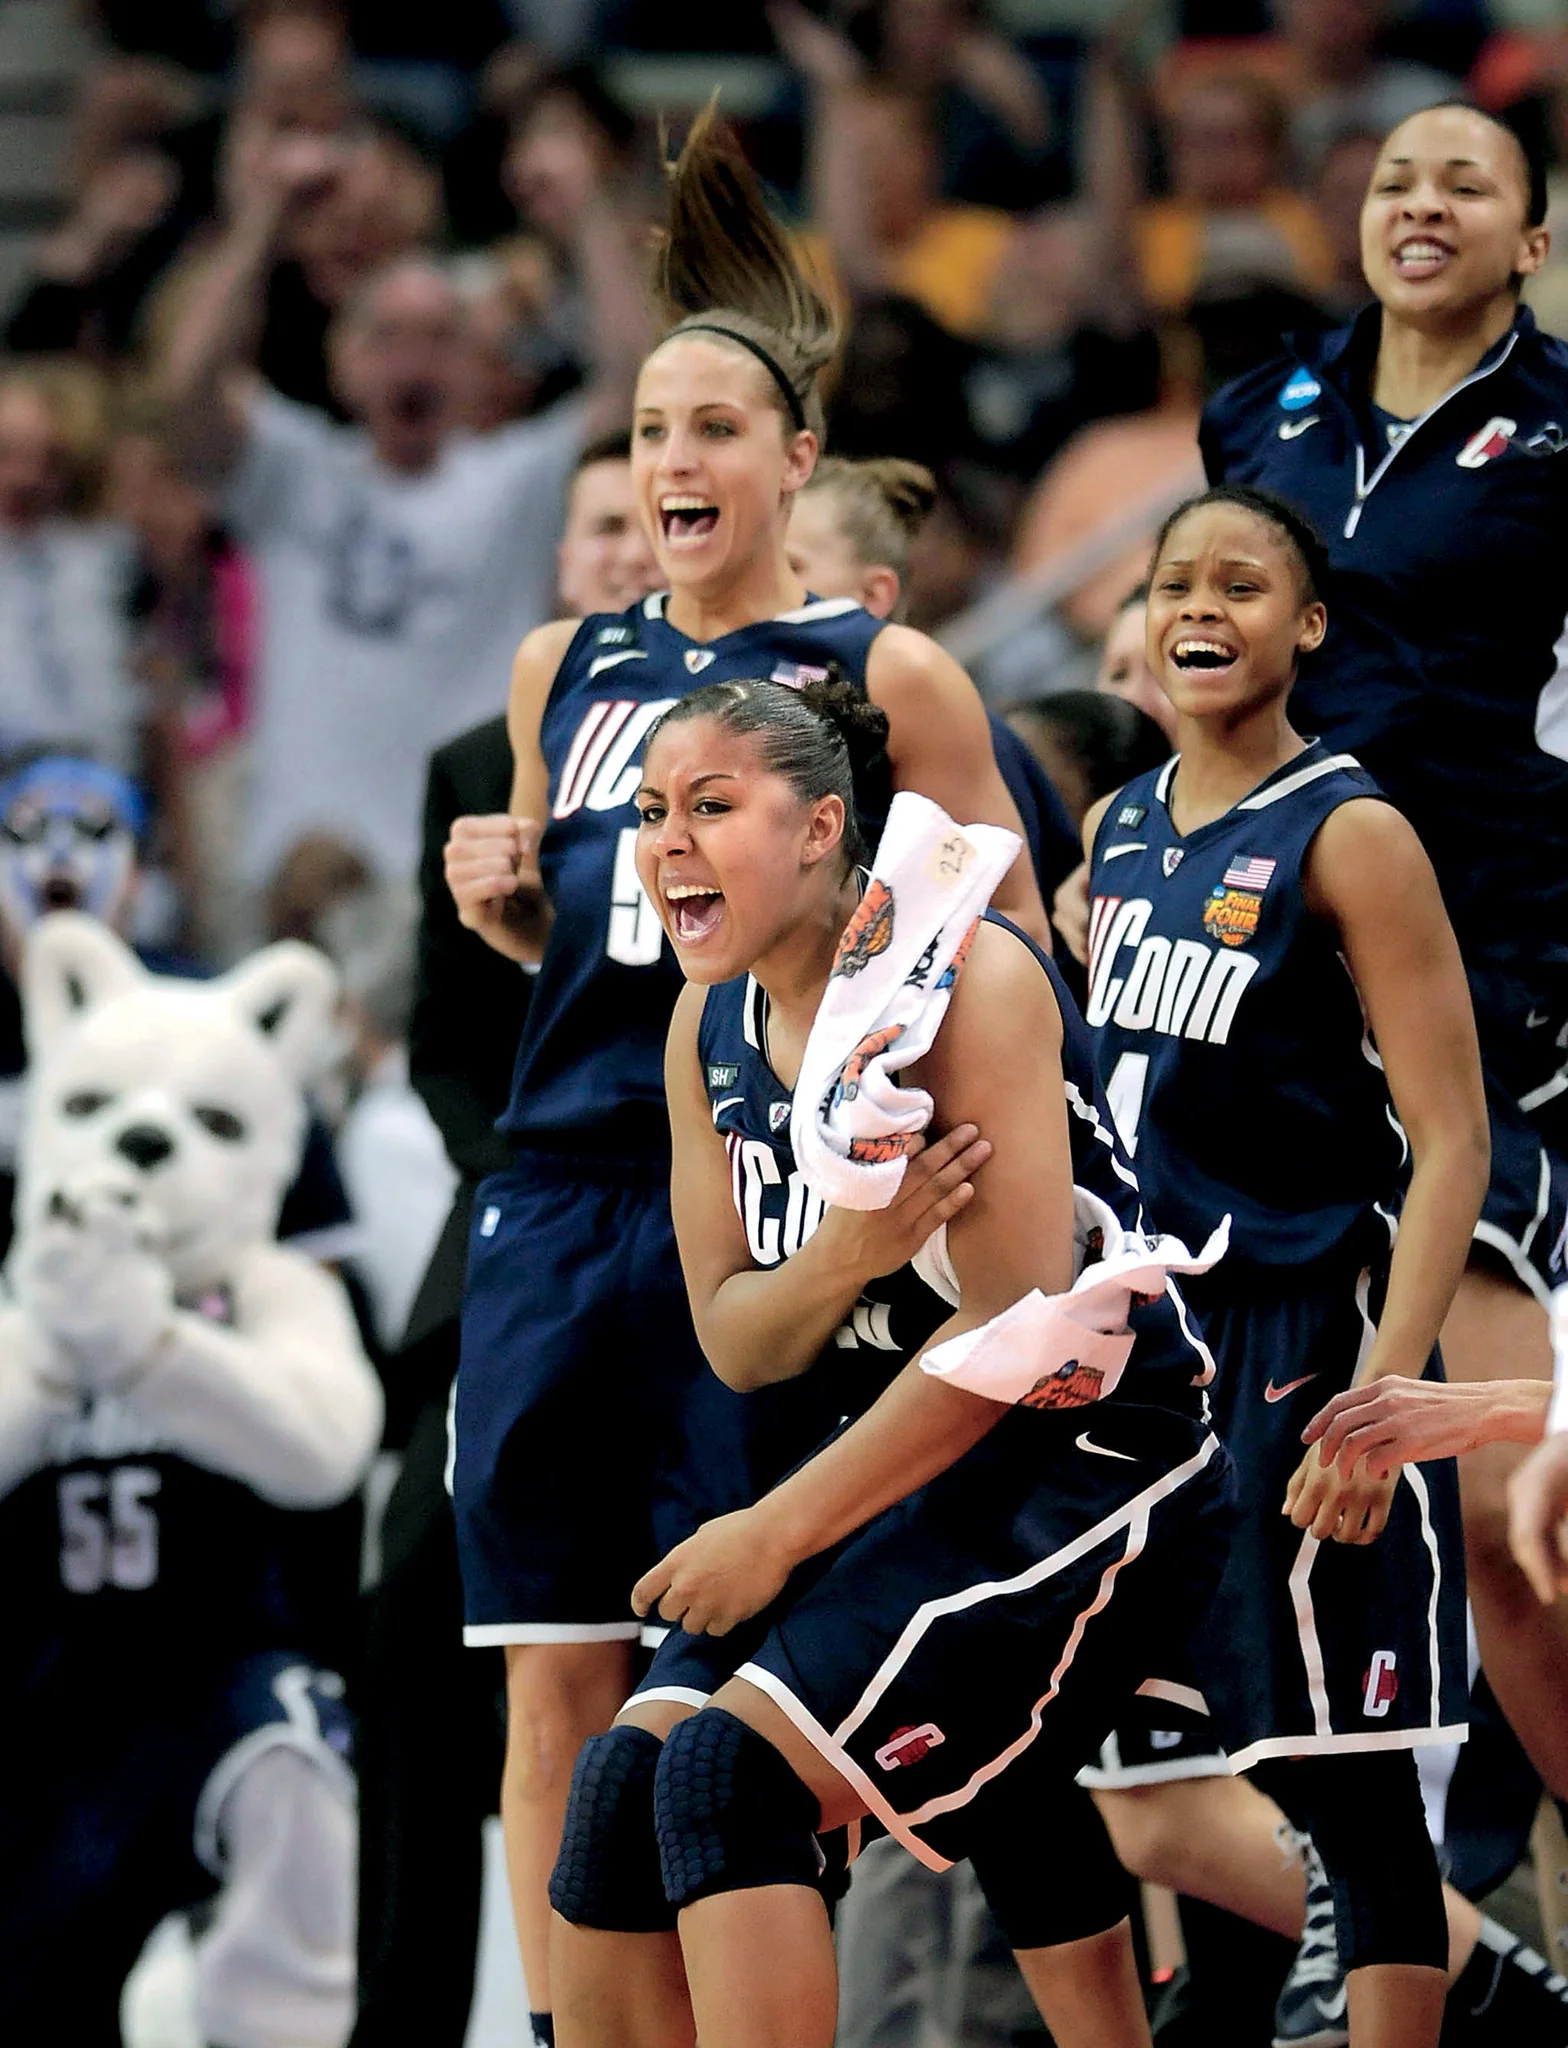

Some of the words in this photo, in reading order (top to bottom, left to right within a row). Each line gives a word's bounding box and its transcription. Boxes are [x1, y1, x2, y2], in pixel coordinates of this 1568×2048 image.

[1457, 417, 1517, 468] C
[1117, 806, 1138, 825] SH
[1203, 900, 1258, 930] FOUR
[1225, 890, 1260, 912] FINAL
[712, 1069, 729, 1086] SH
[56, 1465, 161, 1594] 55
[1362, 1650, 1397, 1717] C
[874, 1723, 945, 1771] C
